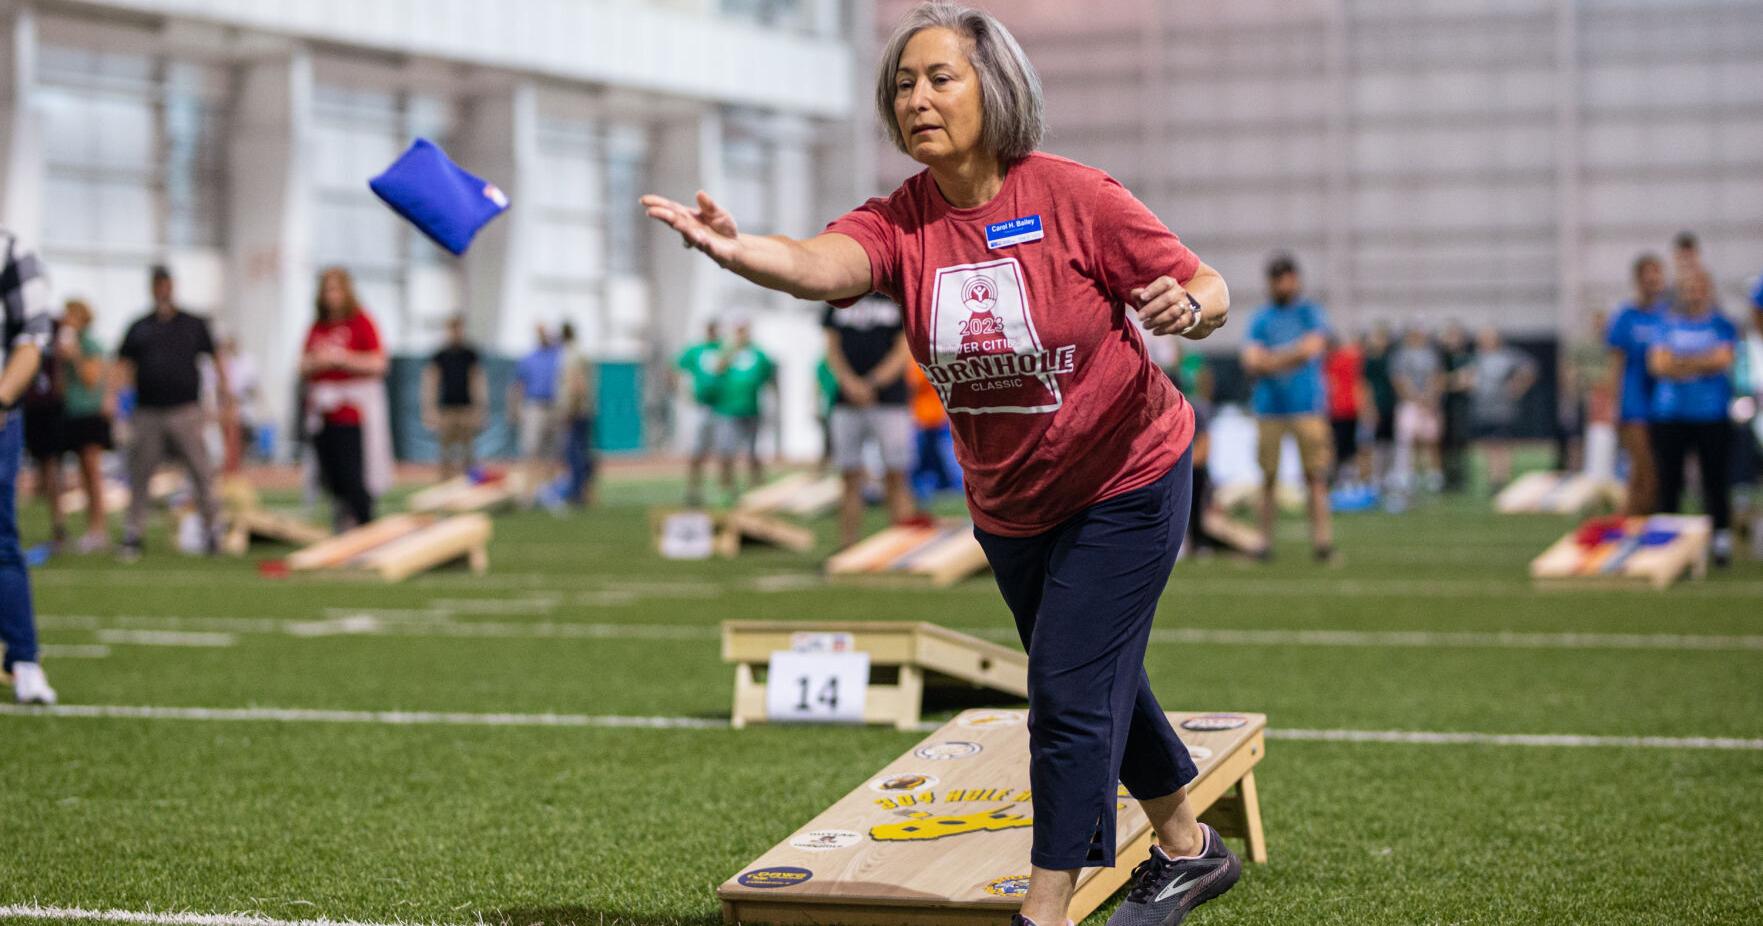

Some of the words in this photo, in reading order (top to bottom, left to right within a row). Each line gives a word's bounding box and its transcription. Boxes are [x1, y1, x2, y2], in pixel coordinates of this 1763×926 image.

[991, 223, 1008, 233] Carol
[1016, 218, 1035, 227] Bailey
[958, 316, 1005, 336] 2023
[971, 378, 1023, 392] CLASSIC
[795, 675, 840, 711] 14
[873, 790, 935, 810] 304
[944, 788, 1014, 803] HOLE
